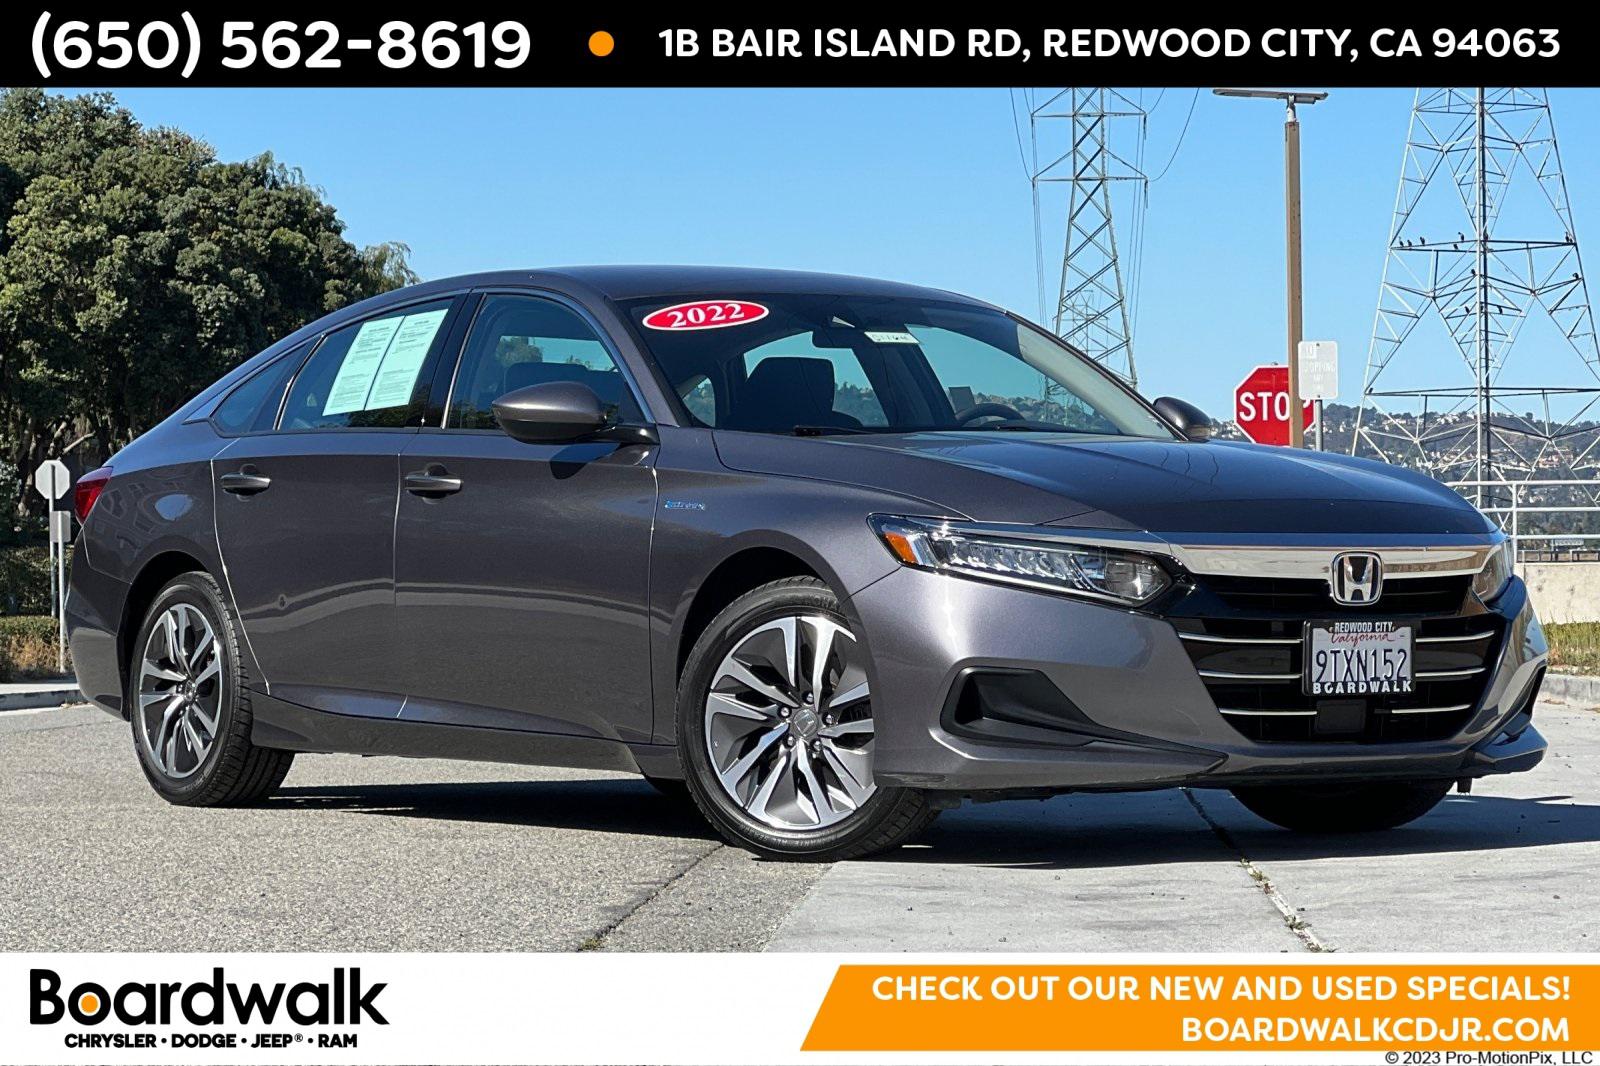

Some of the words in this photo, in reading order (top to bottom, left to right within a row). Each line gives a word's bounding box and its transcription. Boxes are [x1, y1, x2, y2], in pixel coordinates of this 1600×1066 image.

[667, 303, 745, 328] 2022
[1239, 391, 1311, 422] STO
[1334, 622, 1373, 633] REDWOOD
[1375, 621, 1394, 633] CITY
[1330, 632, 1396, 647] California
[1315, 648, 1408, 682] 9TXN152
[1312, 680, 1412, 695] BOARDWALK
